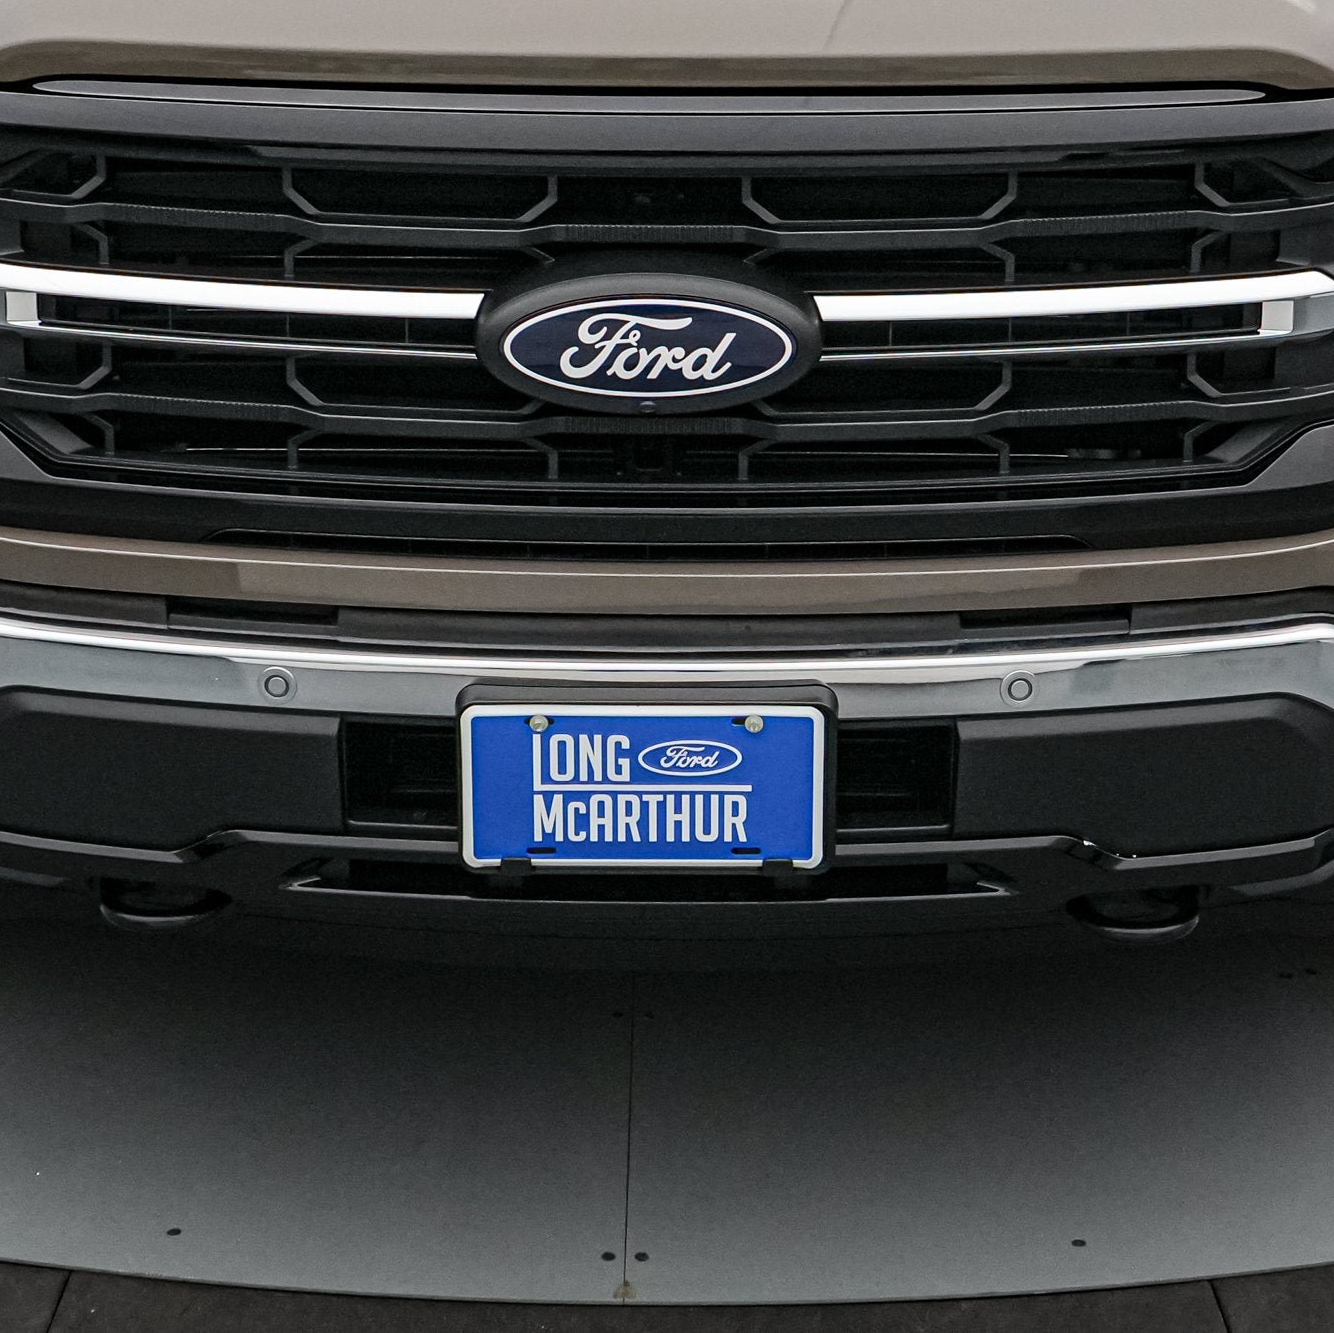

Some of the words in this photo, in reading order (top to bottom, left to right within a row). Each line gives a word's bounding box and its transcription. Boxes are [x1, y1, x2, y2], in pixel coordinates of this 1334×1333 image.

[559, 313, 737, 380] Ford
[532, 733, 631, 791] LONG
[659, 745, 720, 769] Ford
[532, 793, 748, 843] McARTHUR
